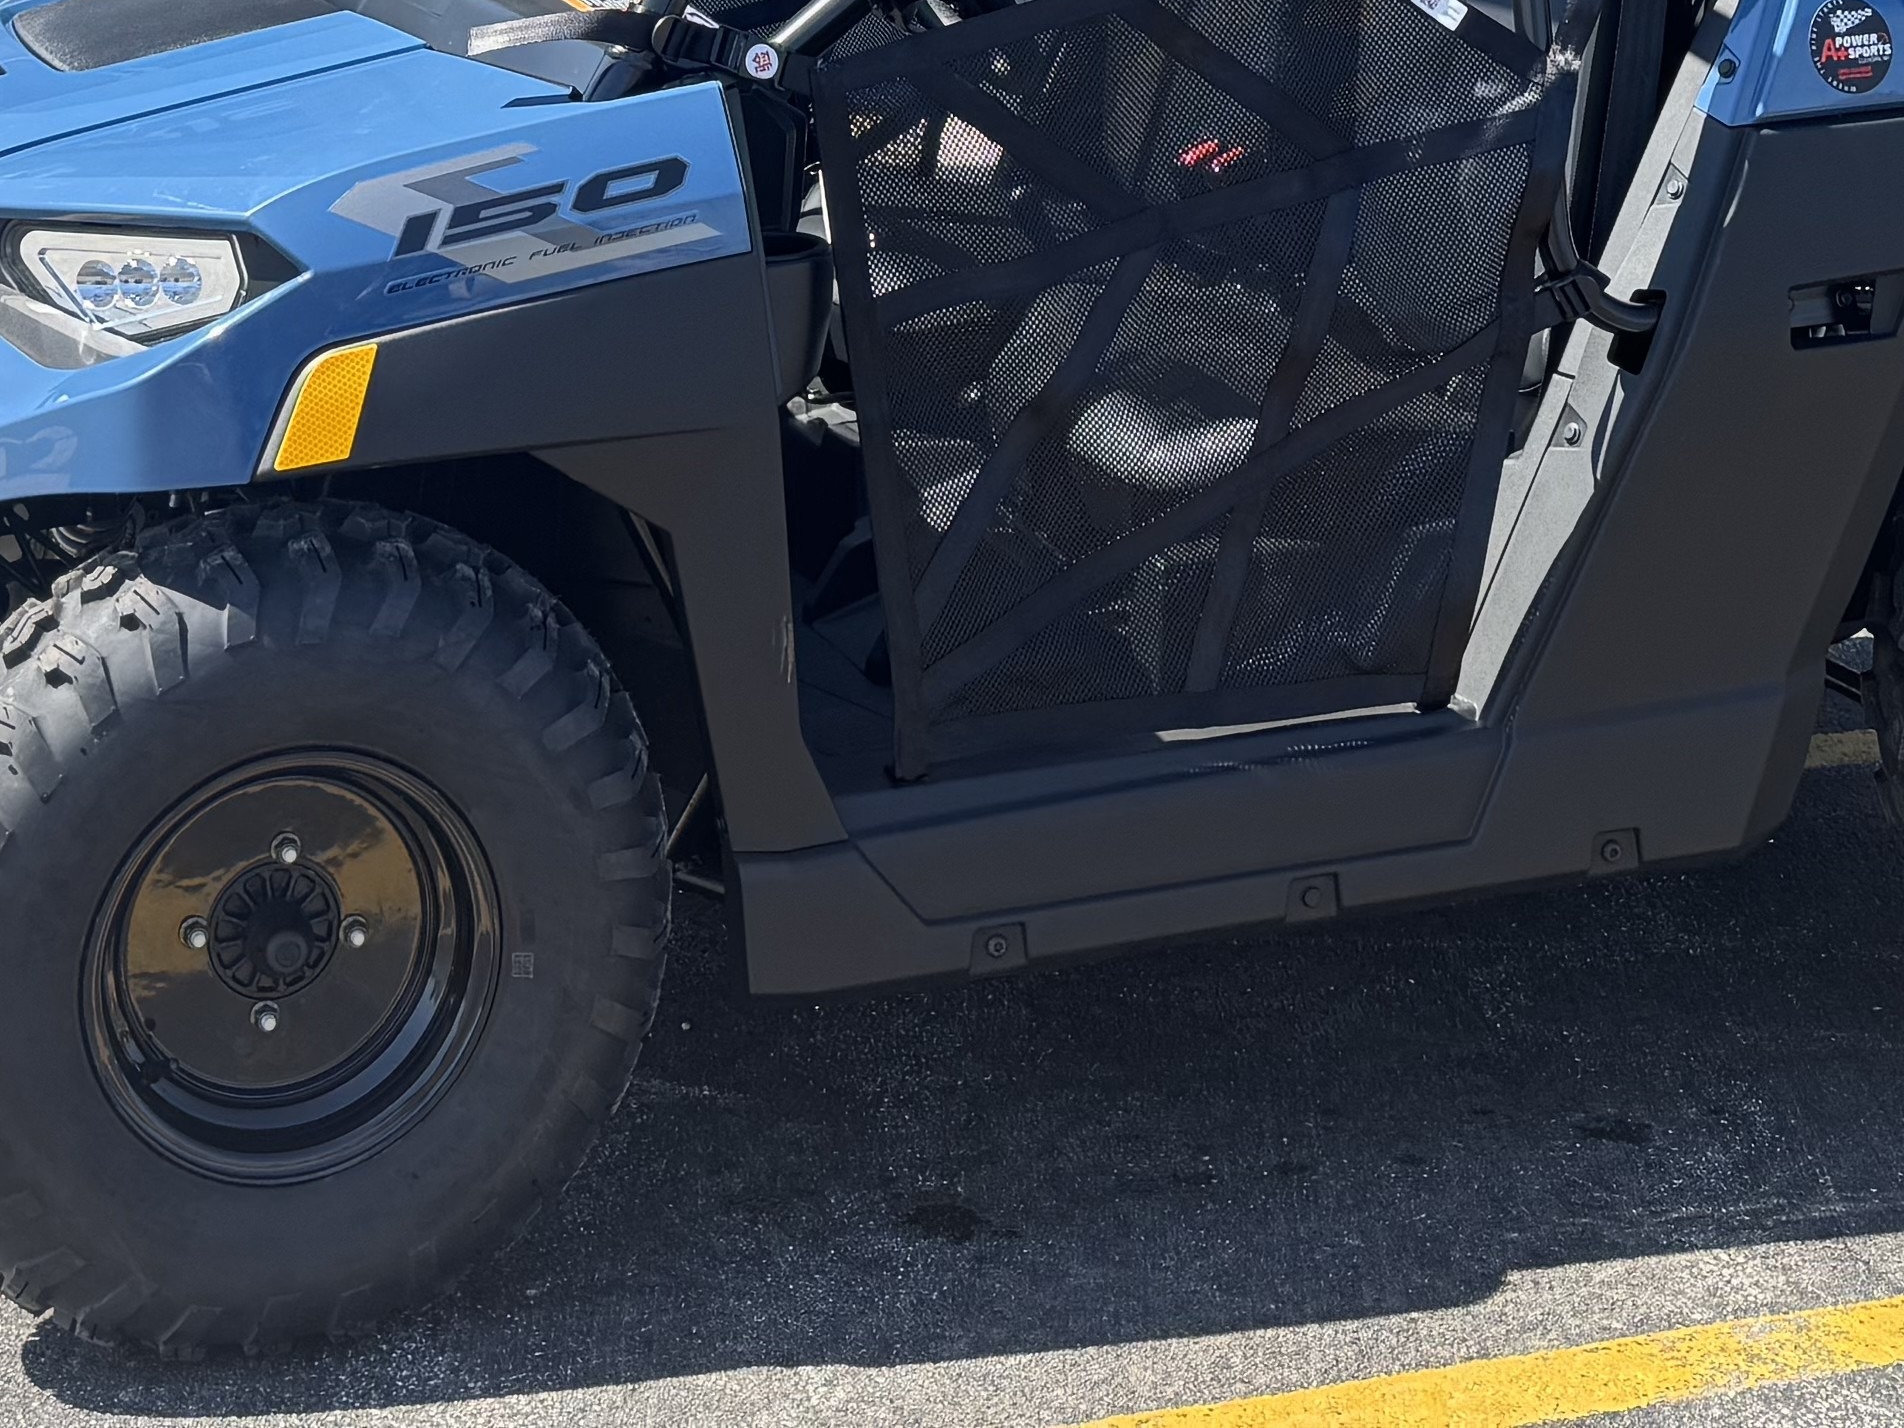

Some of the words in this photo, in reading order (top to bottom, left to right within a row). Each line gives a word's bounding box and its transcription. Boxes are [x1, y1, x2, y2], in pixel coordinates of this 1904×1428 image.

[1821, 39, 1848, 63] A+
[1835, 33, 1878, 48] POWER
[1848, 43, 1891, 59] SPORTS
[388, 153, 692, 261] 150
[386, 256, 517, 295] ELECTRONIC
[528, 241, 582, 261] FUEL
[593, 212, 698, 247] INJECTION
